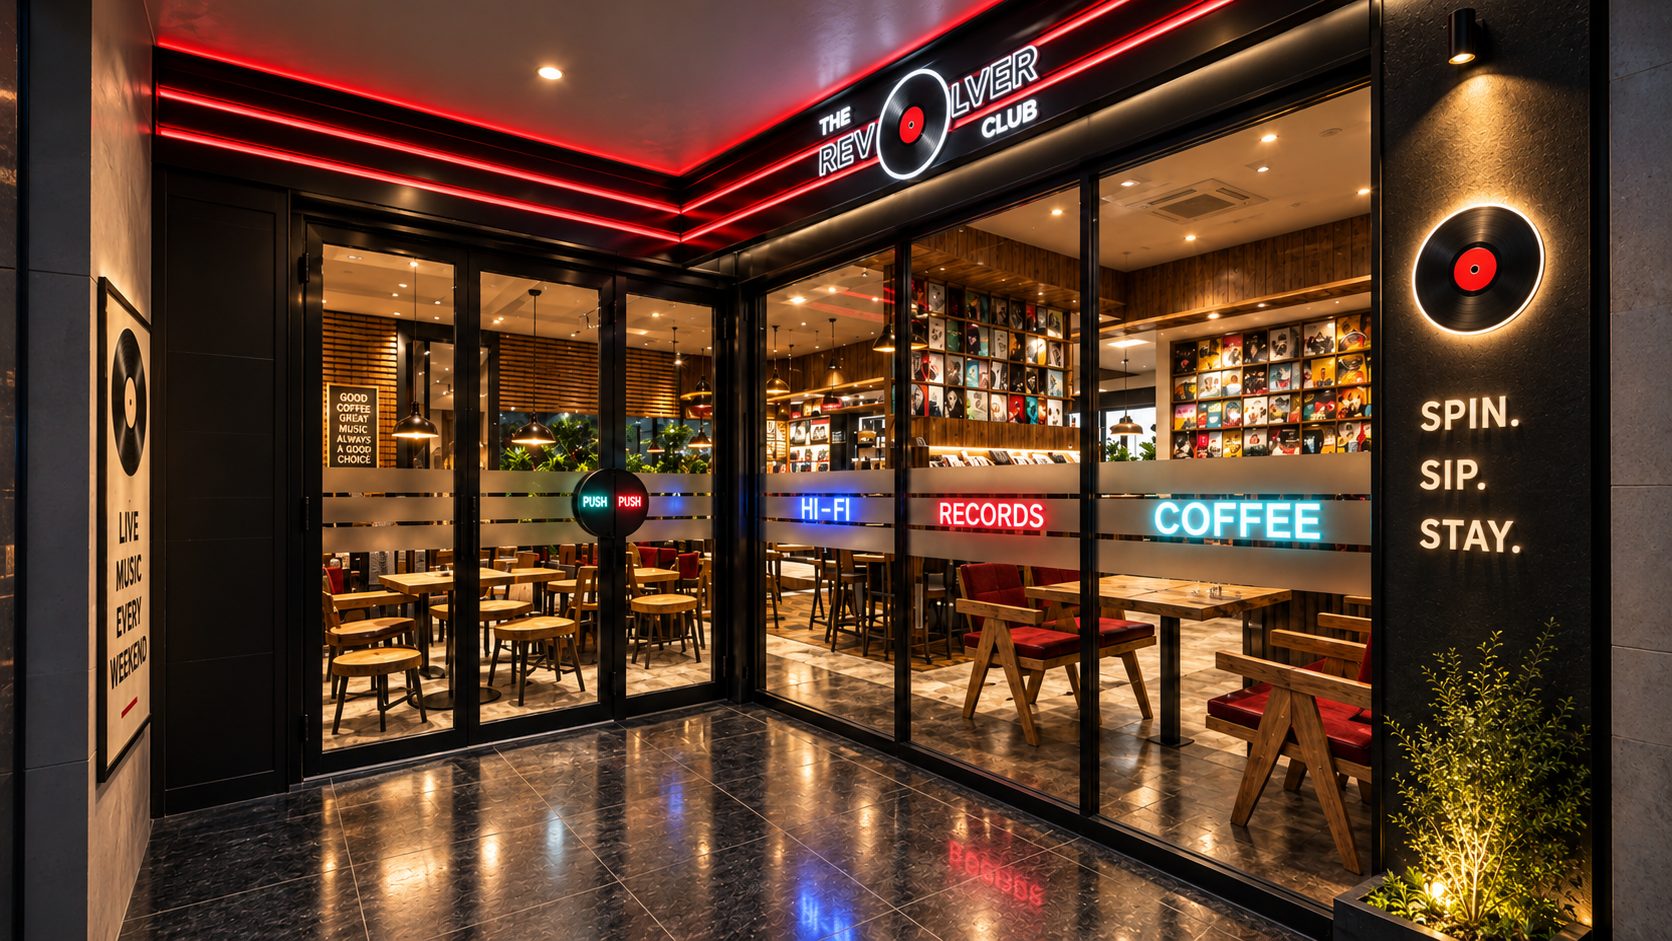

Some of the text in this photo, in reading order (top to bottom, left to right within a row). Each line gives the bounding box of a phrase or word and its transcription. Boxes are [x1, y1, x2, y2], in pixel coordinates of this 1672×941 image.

[819, 106, 851, 136] THE
[981, 99, 1039, 138] CLUB
[336, 403, 371, 414] COFFEE
[339, 392, 368, 403] GOOD
[1420, 395, 1520, 431] SPIN.
[336, 434, 372, 445] ALWAYS
[338, 424, 368, 433] MUSIC
[336, 444, 372, 455] A GOOD
[337, 455, 371, 464] CHOICE
[1419, 459, 1486, 491] SIP.
[582, 495, 608, 508] PUSH
[618, 495, 642, 508] PUSH
[801, 497, 850, 522] HI-FI
[939, 502, 1044, 528] RECORDS
[119, 511, 139, 545] LIVE
[1154, 501, 1321, 540] COFFEE
[1419, 518, 1521, 554] STAY.
[116, 554, 142, 592] MUSIC
[116, 596, 142, 639] EVERY
[109, 635, 148, 690] WEEKEND
